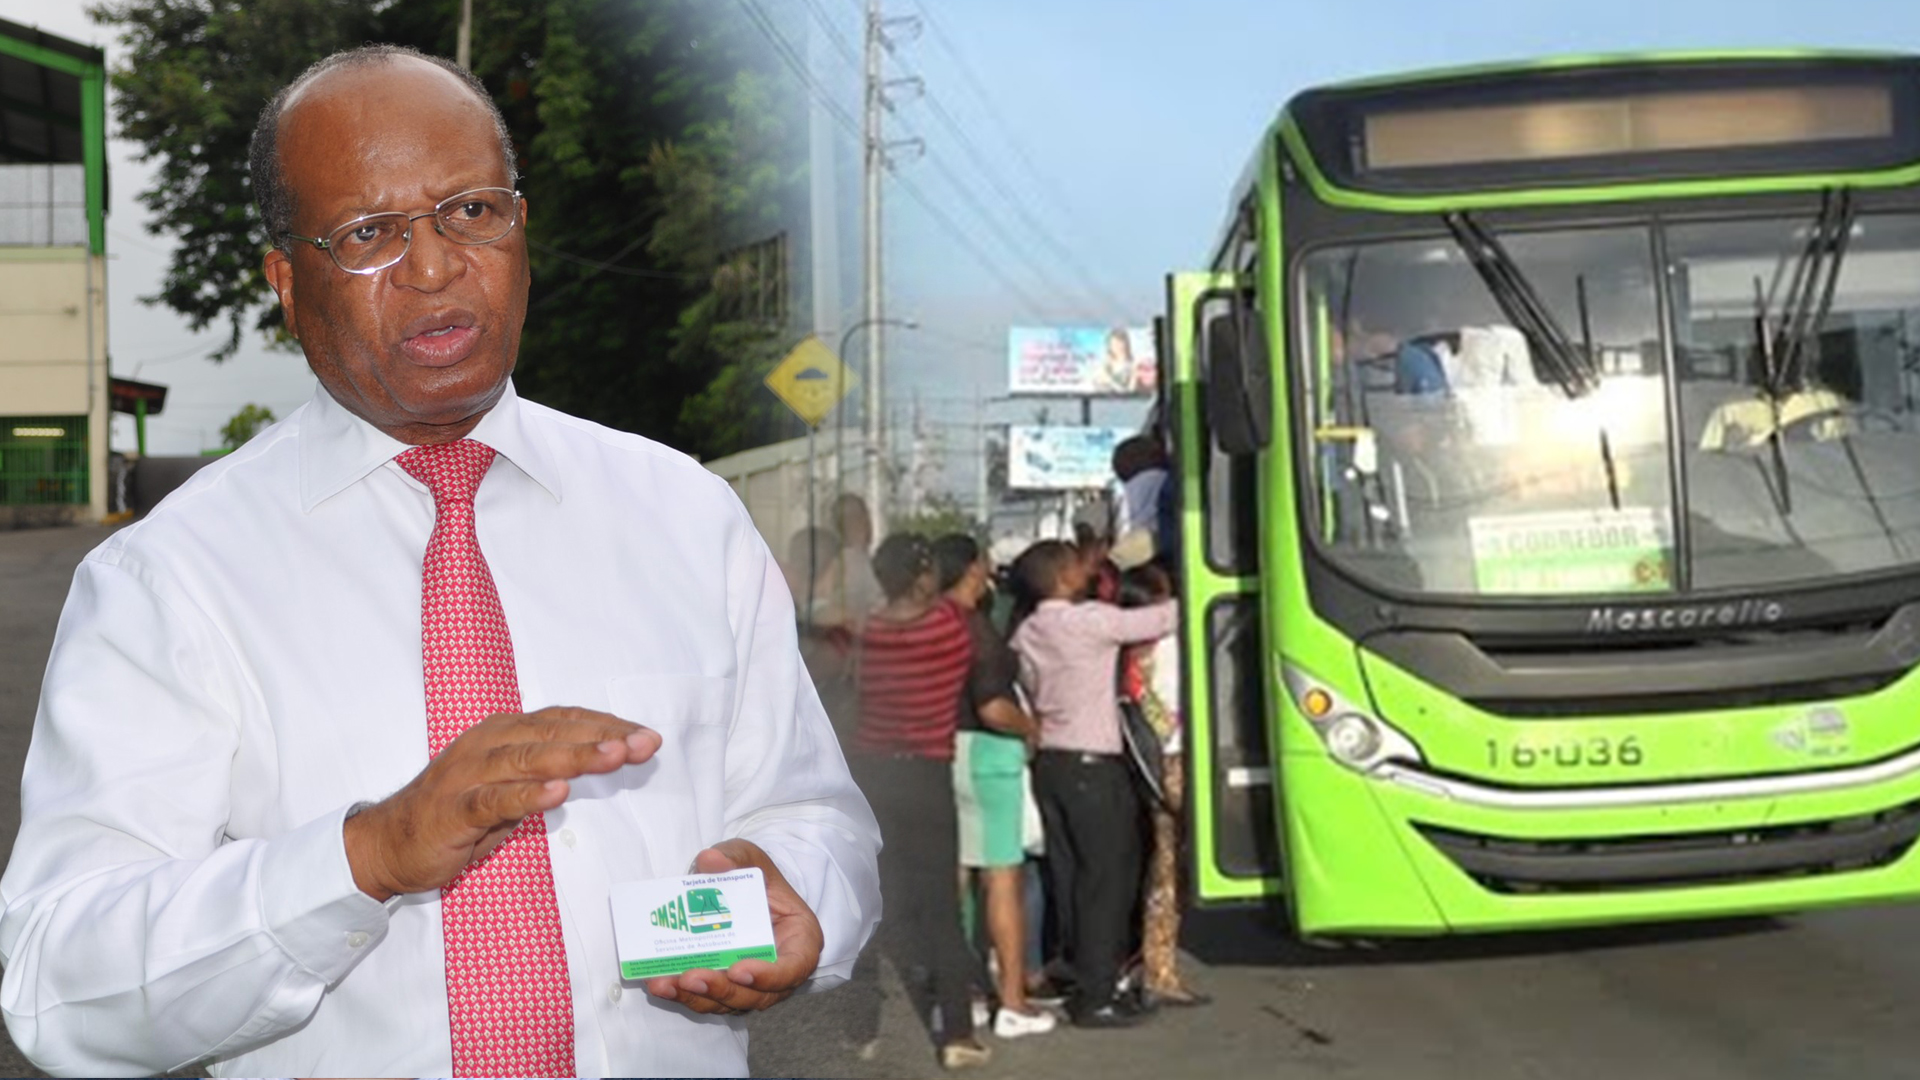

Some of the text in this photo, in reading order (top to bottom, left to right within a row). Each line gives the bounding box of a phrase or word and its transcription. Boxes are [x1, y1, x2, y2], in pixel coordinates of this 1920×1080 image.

[1587, 599, 1784, 633] Mascarello
[1486, 735, 1643, 768] 16-036
[682, 873, 754, 887] Tarjeta de transporte
[650, 895, 690, 932] OMSA
